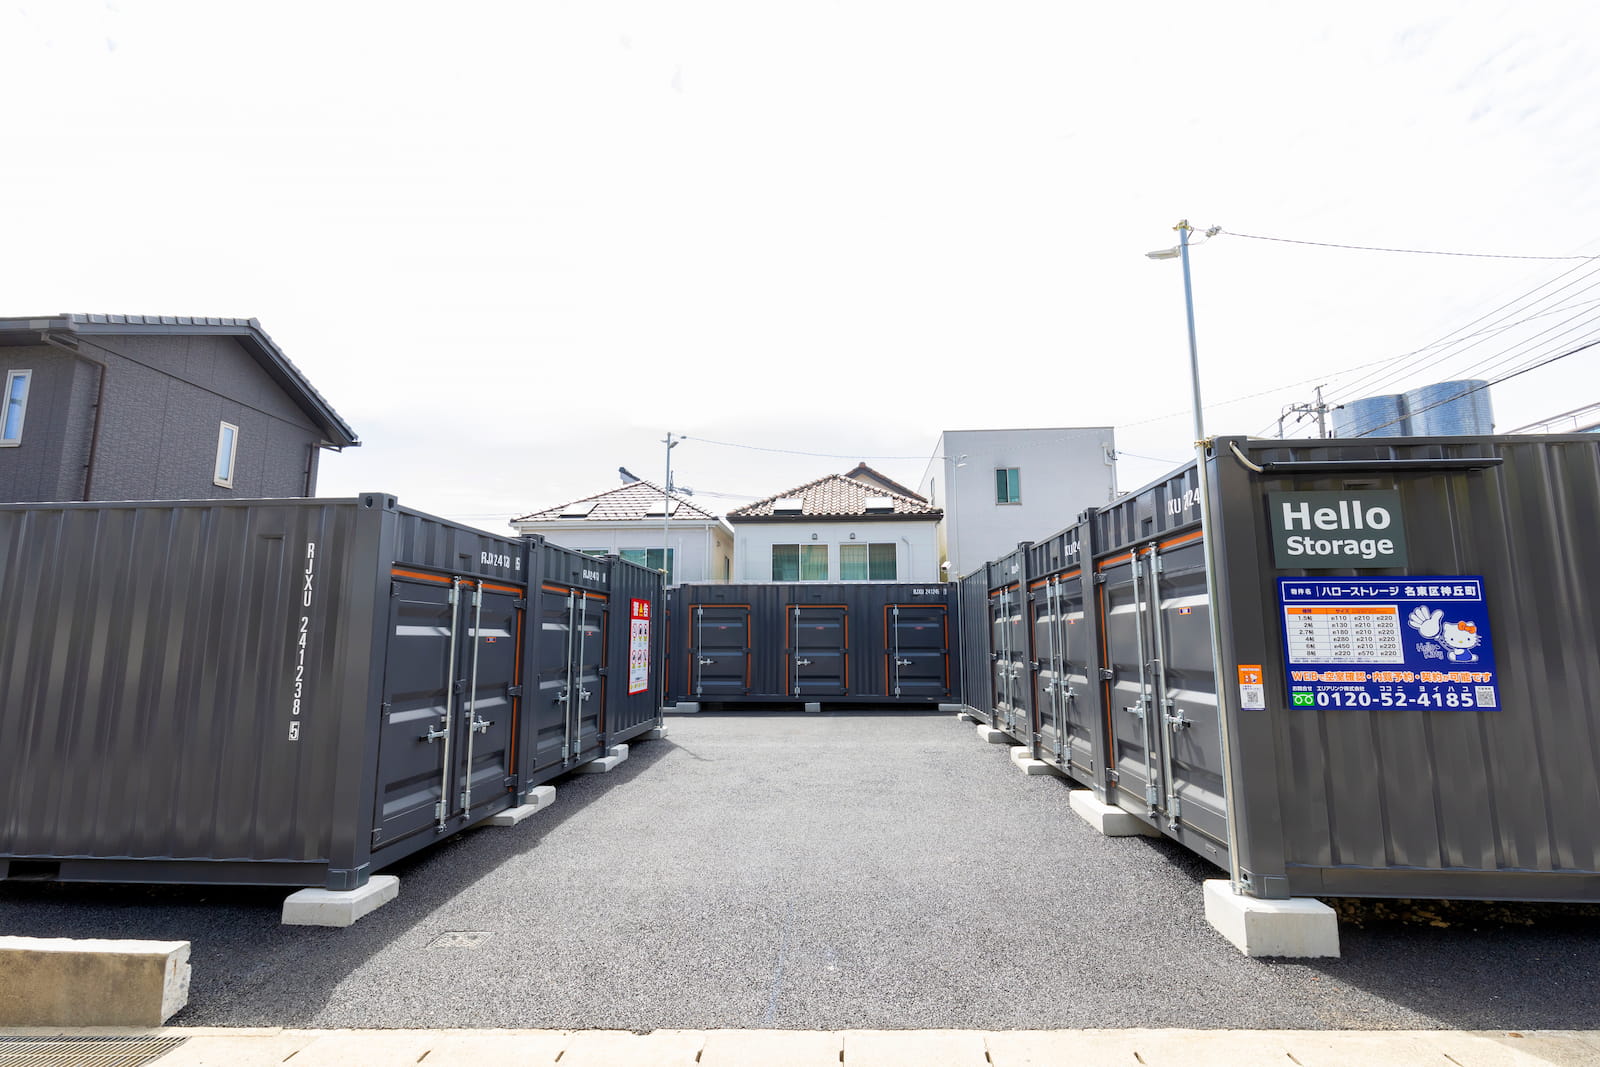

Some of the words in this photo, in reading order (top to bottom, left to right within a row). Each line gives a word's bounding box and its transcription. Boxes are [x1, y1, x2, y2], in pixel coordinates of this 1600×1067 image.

[1282, 500, 1391, 531] Hello
[1286, 535, 1395, 560] Storage
[303, 542, 316, 607] RJXU
[1321, 586, 1399, 597] ハローストレージ
[1404, 585, 1476, 597] 名東区神丘町
[292, 616, 309, 716] 241238
[1316, 692, 1474, 707] 0120-52-4185
[290, 723, 299, 740] 5
